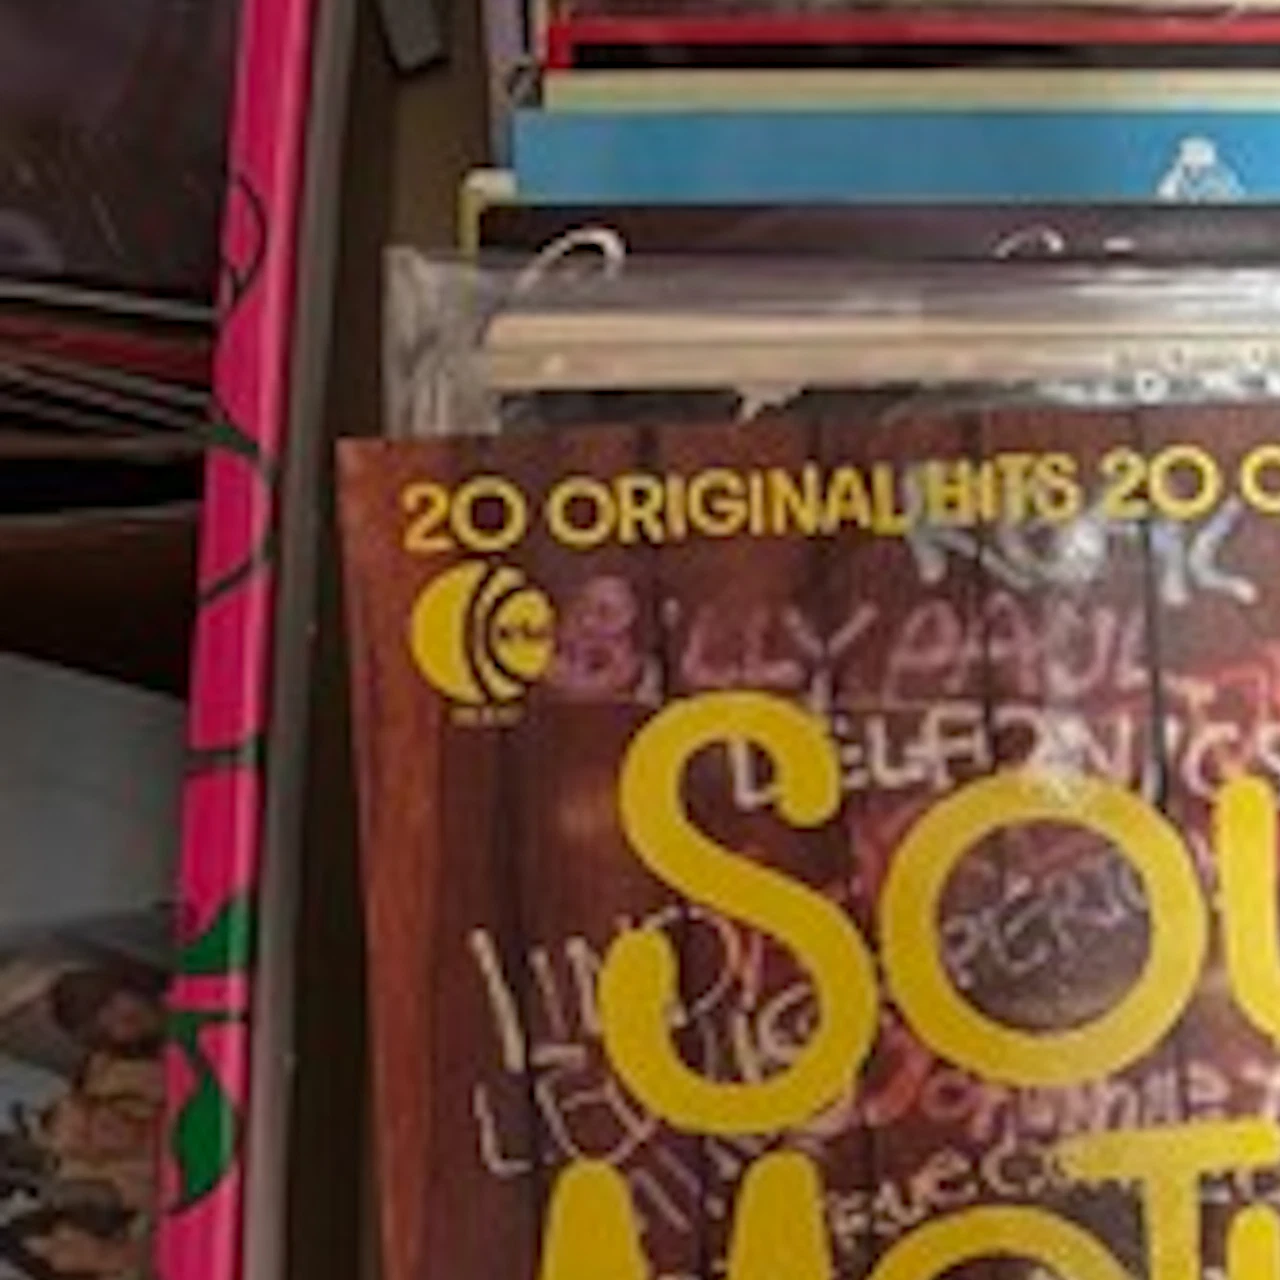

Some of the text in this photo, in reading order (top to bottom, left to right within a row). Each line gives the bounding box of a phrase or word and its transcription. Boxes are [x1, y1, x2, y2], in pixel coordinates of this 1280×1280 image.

[402, 477, 527, 552] 20
[547, 462, 912, 548] ORIGINAL
[925, 451, 1080, 526] HITS
[1101, 444, 1220, 519] 20
